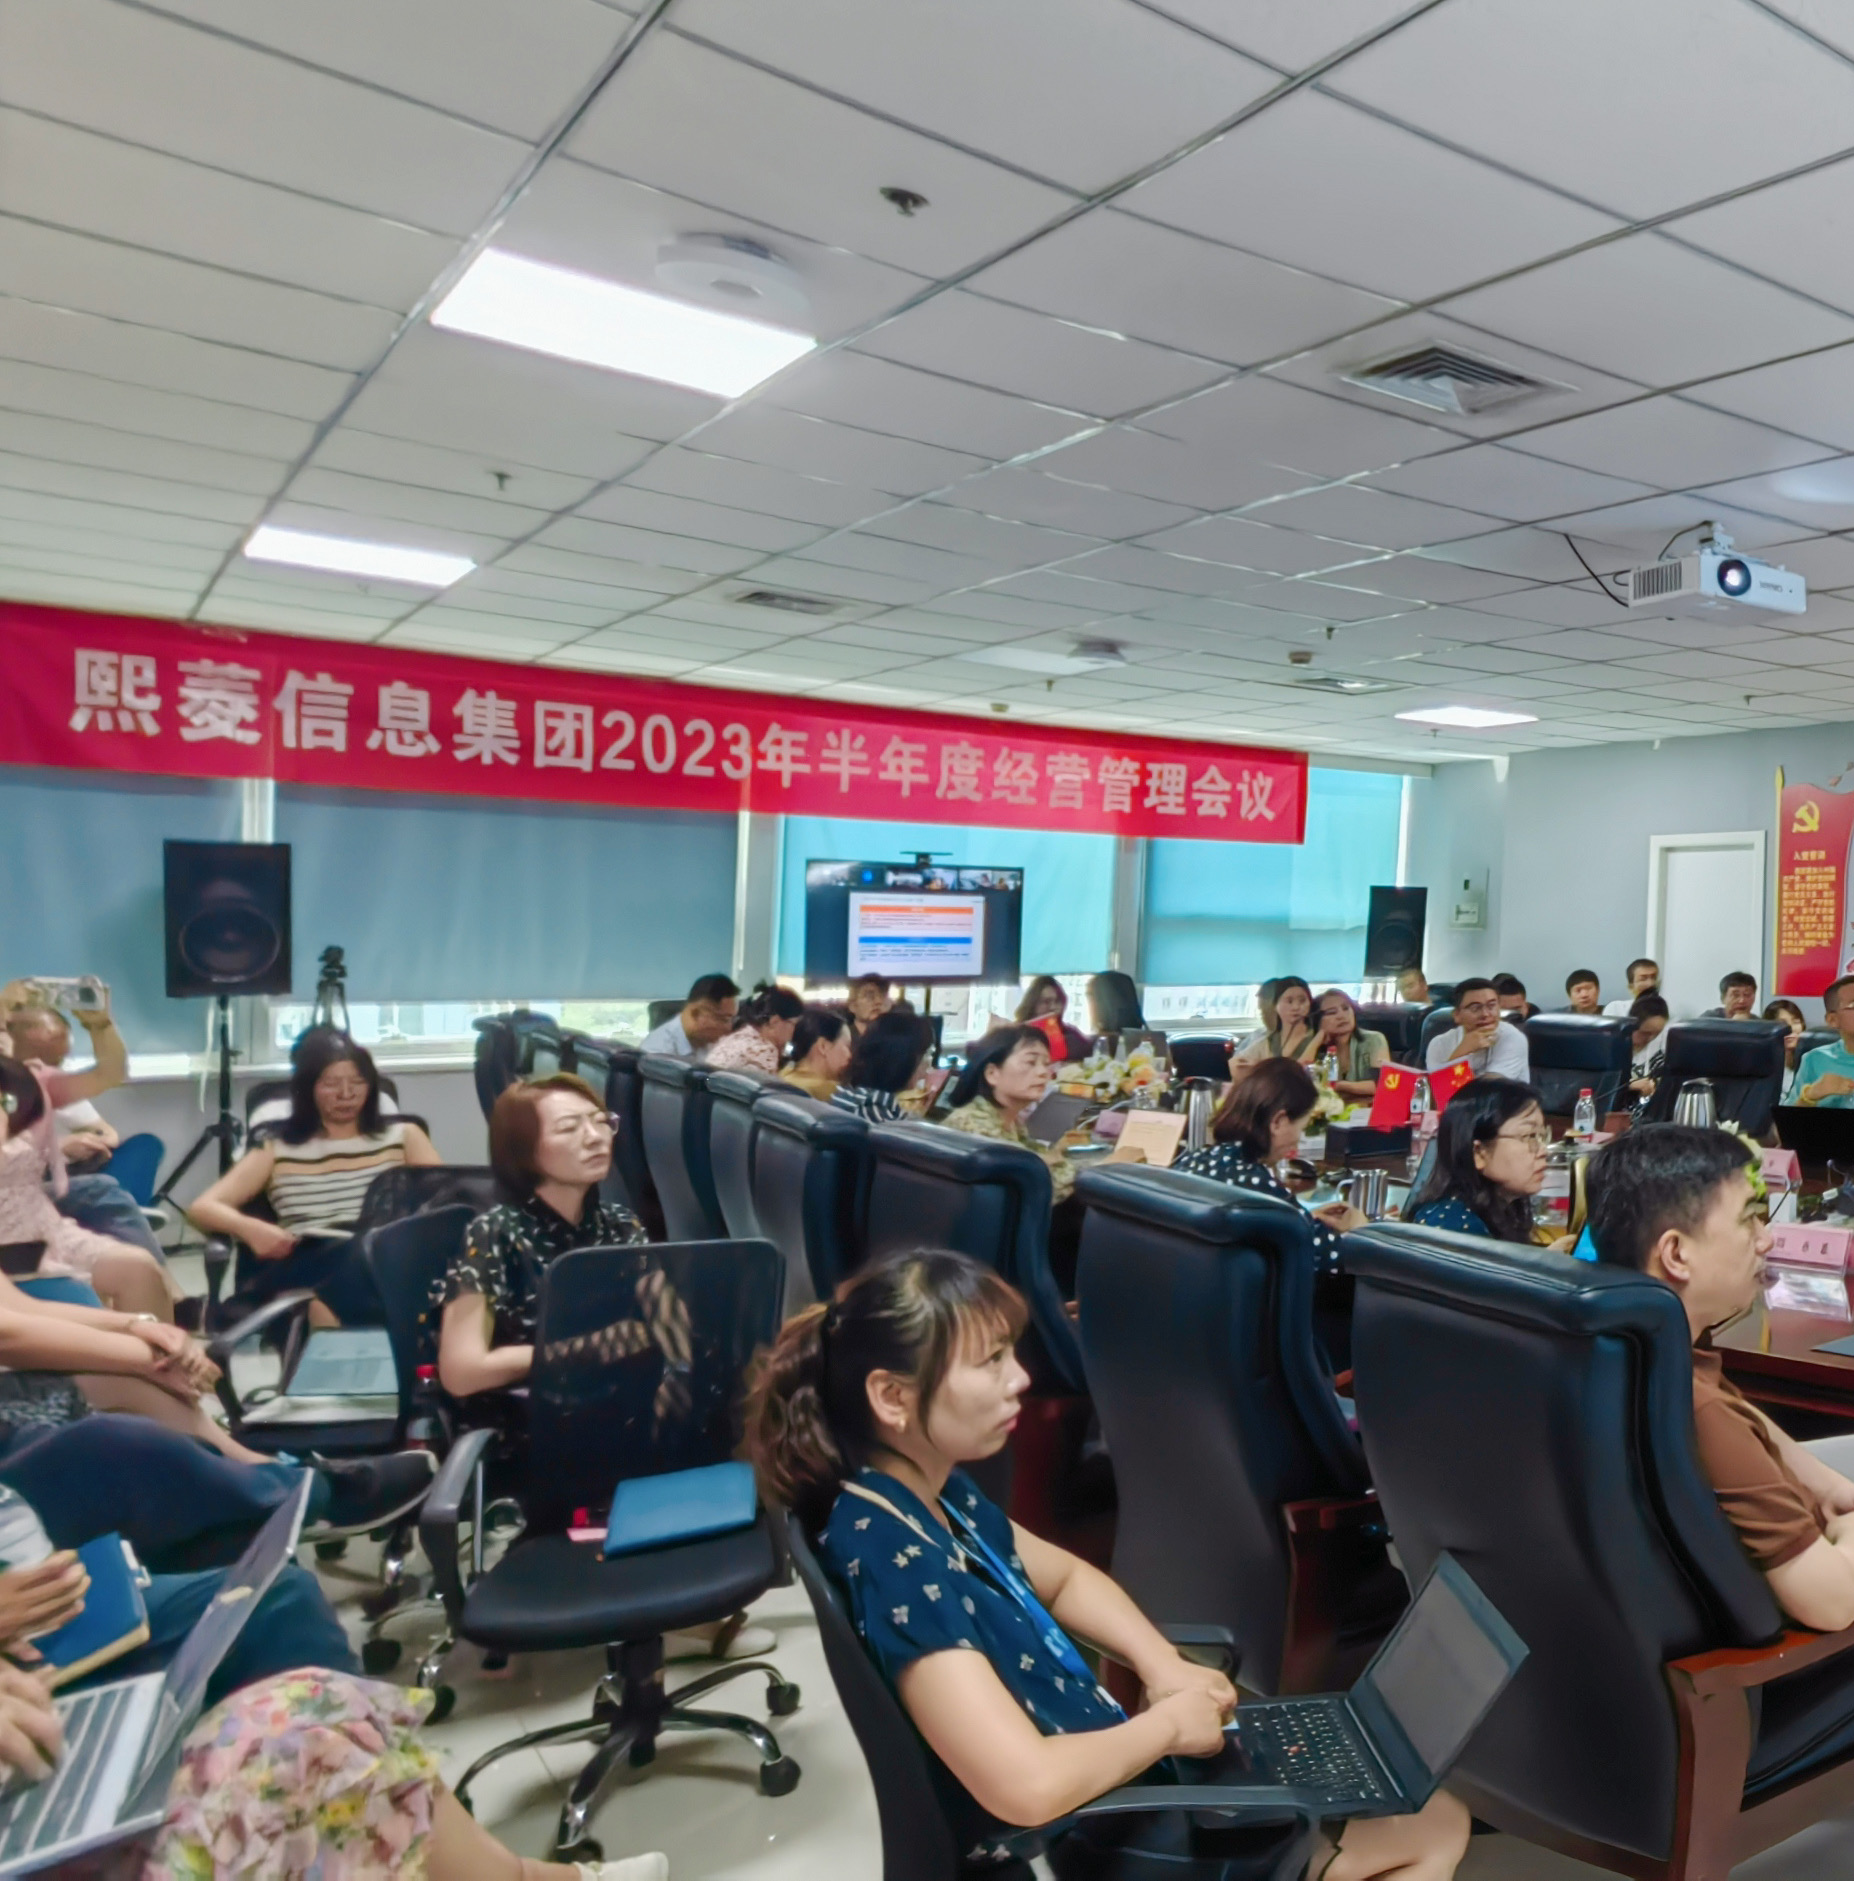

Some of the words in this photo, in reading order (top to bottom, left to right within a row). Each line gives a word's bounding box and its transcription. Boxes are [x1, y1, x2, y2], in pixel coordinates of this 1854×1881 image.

[68, 647, 1276, 822] 熙菱信息集团2023年半年度经营管理会议
